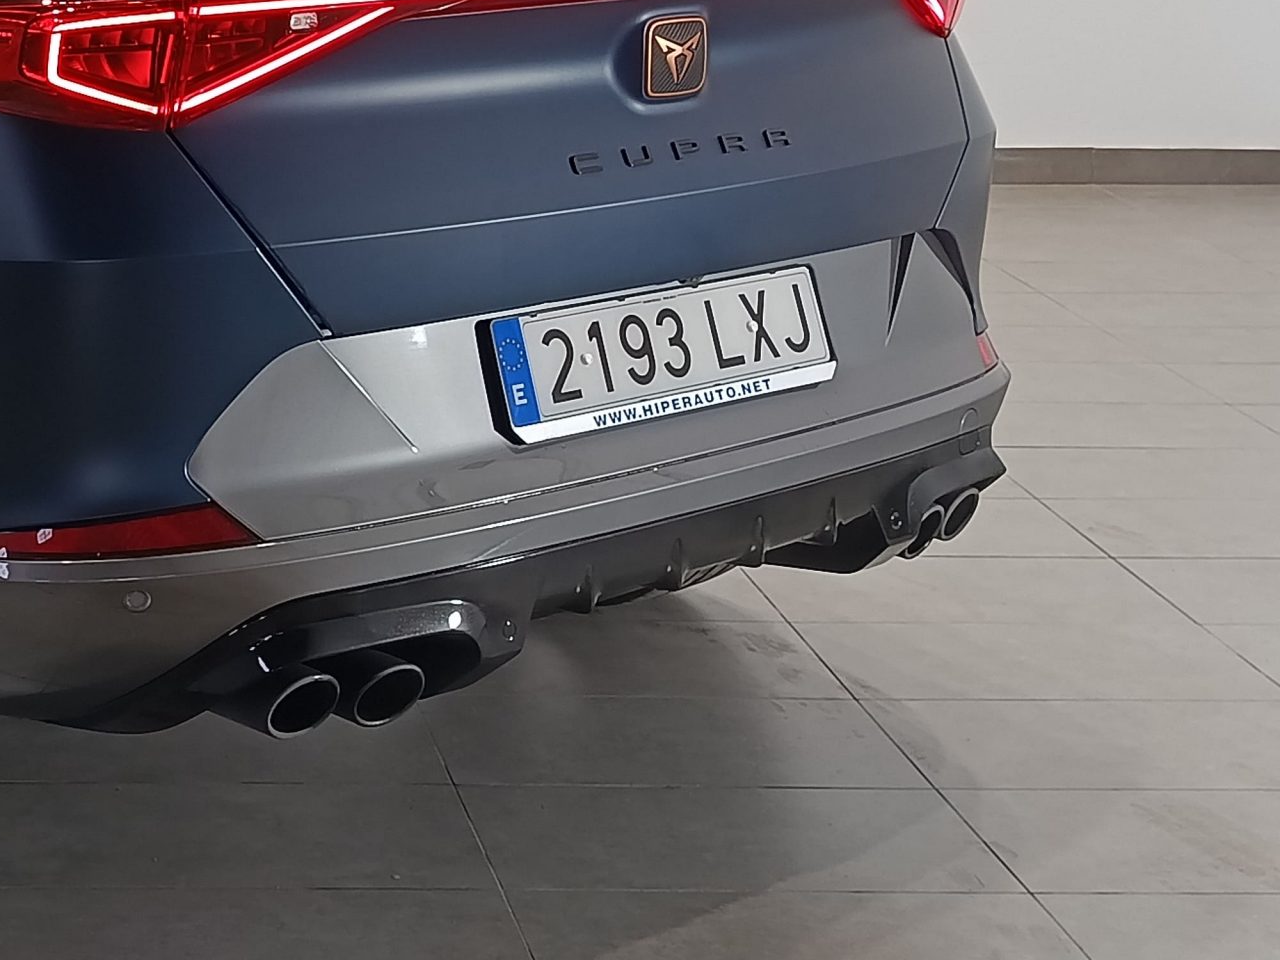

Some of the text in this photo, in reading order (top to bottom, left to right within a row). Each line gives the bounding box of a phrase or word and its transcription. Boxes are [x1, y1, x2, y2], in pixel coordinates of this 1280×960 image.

[540, 283, 811, 404] 2193 LXJ
[511, 382, 528, 406] E
[592, 378, 772, 428] WWW.HIPERAUTO.NET
